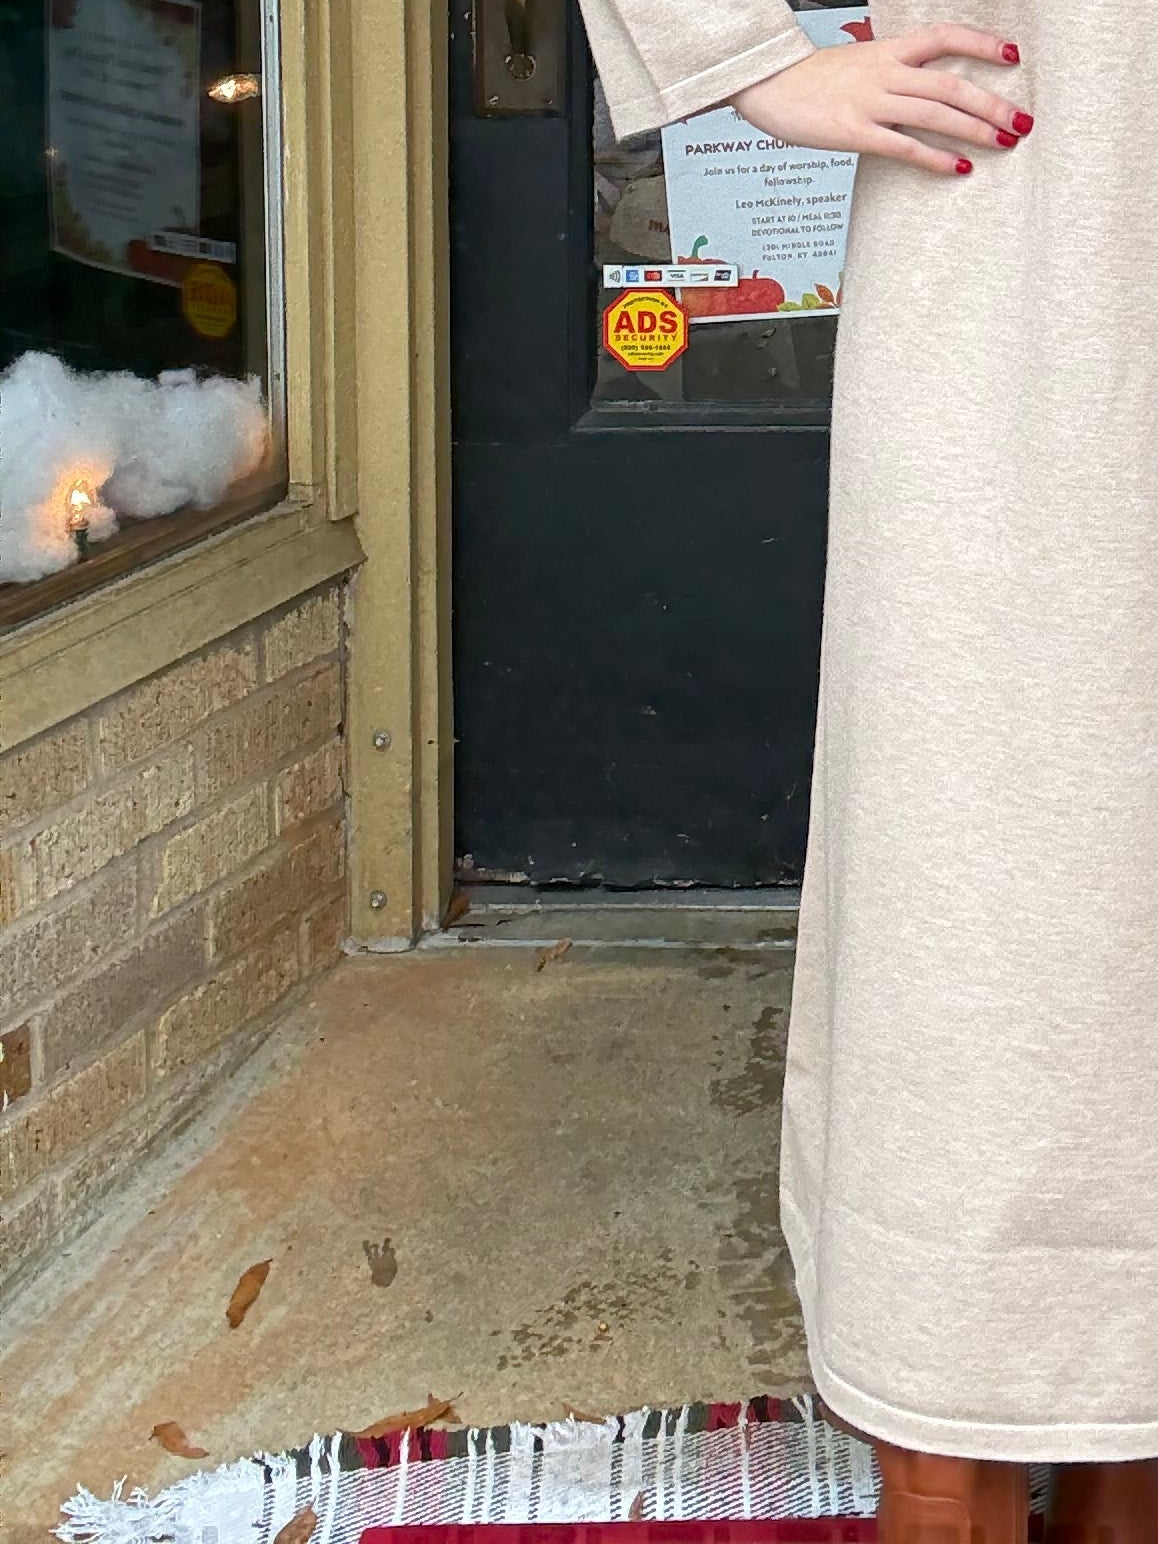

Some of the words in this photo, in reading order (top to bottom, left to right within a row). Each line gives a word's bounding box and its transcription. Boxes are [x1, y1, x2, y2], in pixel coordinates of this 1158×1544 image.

[685, 140, 752, 156] PARKWAY
[756, 139, 801, 151] CHU
[703, 167, 723, 177] Join
[737, 164, 750, 175] for
[760, 163, 776, 174] day
[778, 161, 787, 171] of
[806, 192, 847, 206] speaker
[752, 215, 775, 225] START
[802, 212, 822, 221] MEAL
[752, 227, 800, 236] DEVOTIONAL
[800, 225, 811, 233] TO
[813, 223, 844, 232] FOLLOW
[614, 310, 678, 333] ADS
[614, 334, 677, 342] SECURITY
